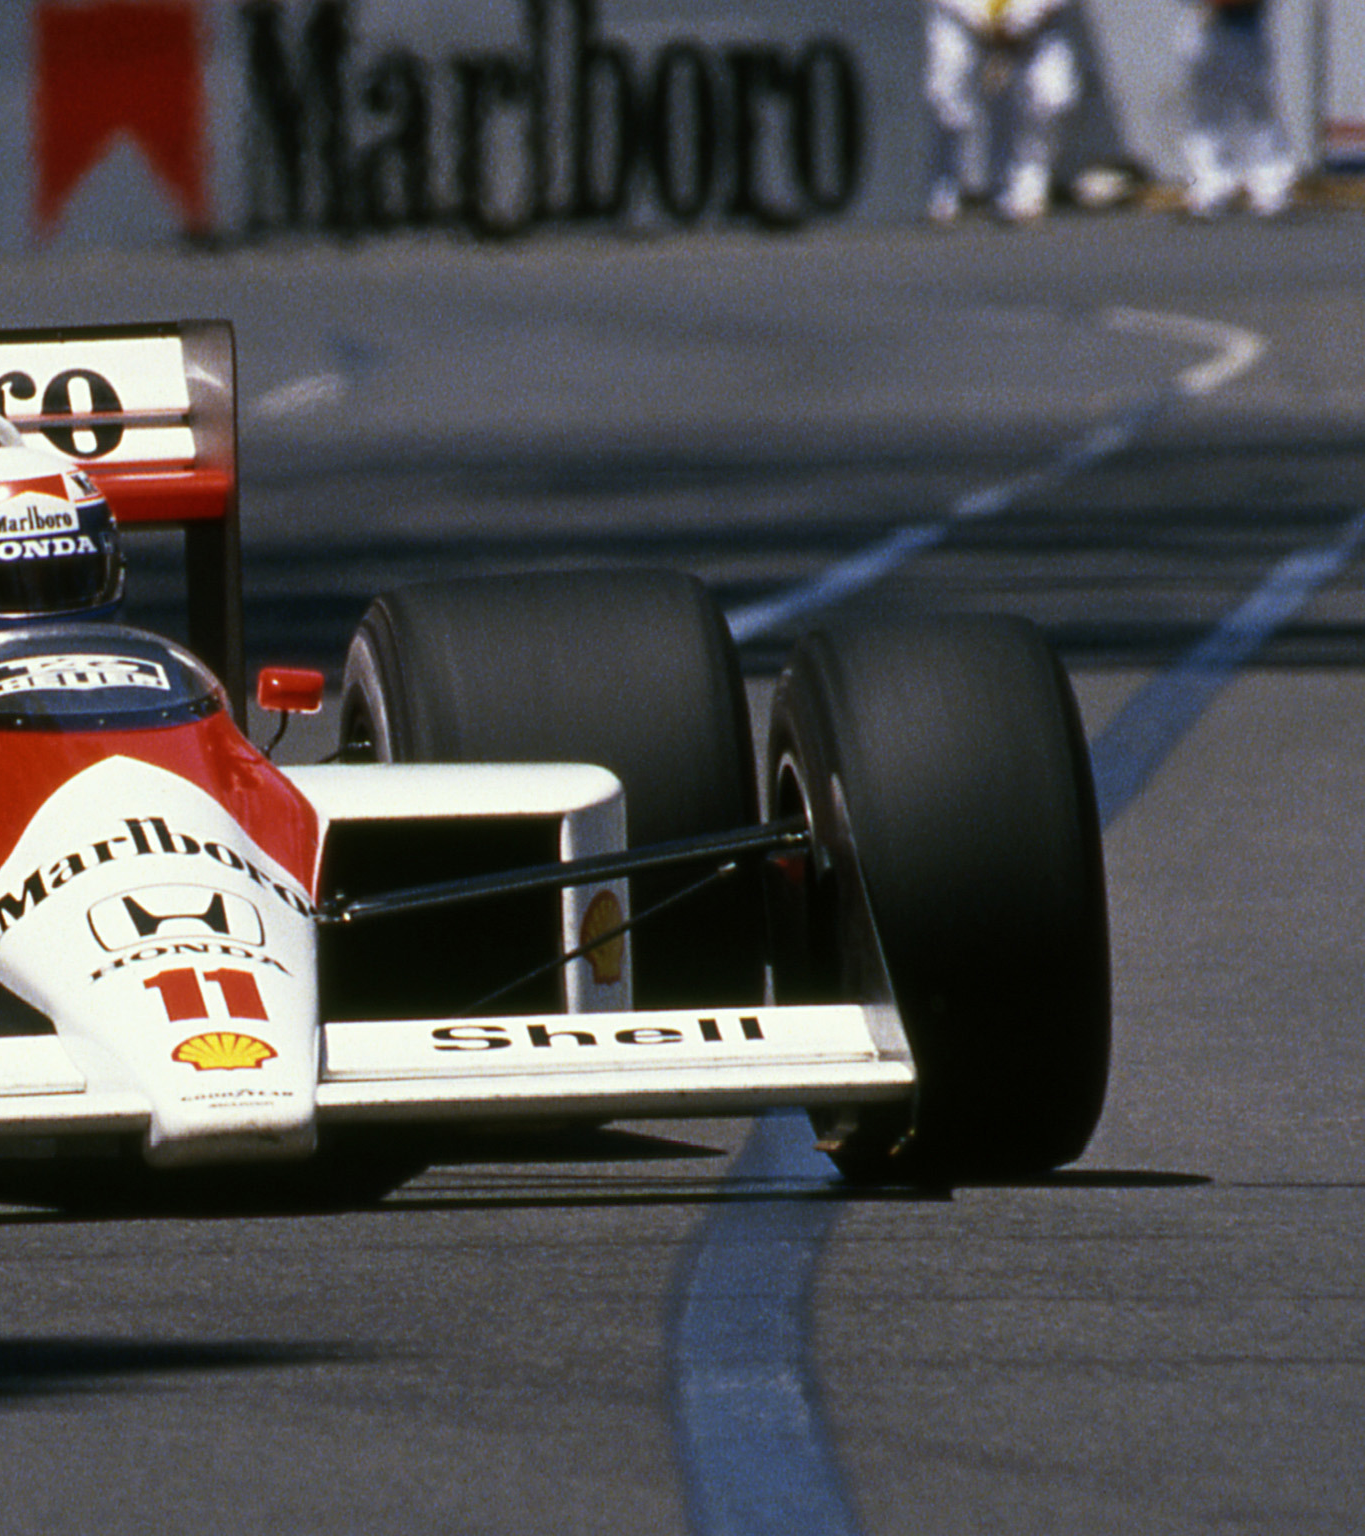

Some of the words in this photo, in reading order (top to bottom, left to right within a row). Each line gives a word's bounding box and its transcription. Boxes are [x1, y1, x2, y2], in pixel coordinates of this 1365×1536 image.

[246, 0, 864, 237] Marlboro
[90, 943, 294, 984] HONDA
[143, 966, 270, 1023] 11
[431, 1016, 765, 1052] Shell
